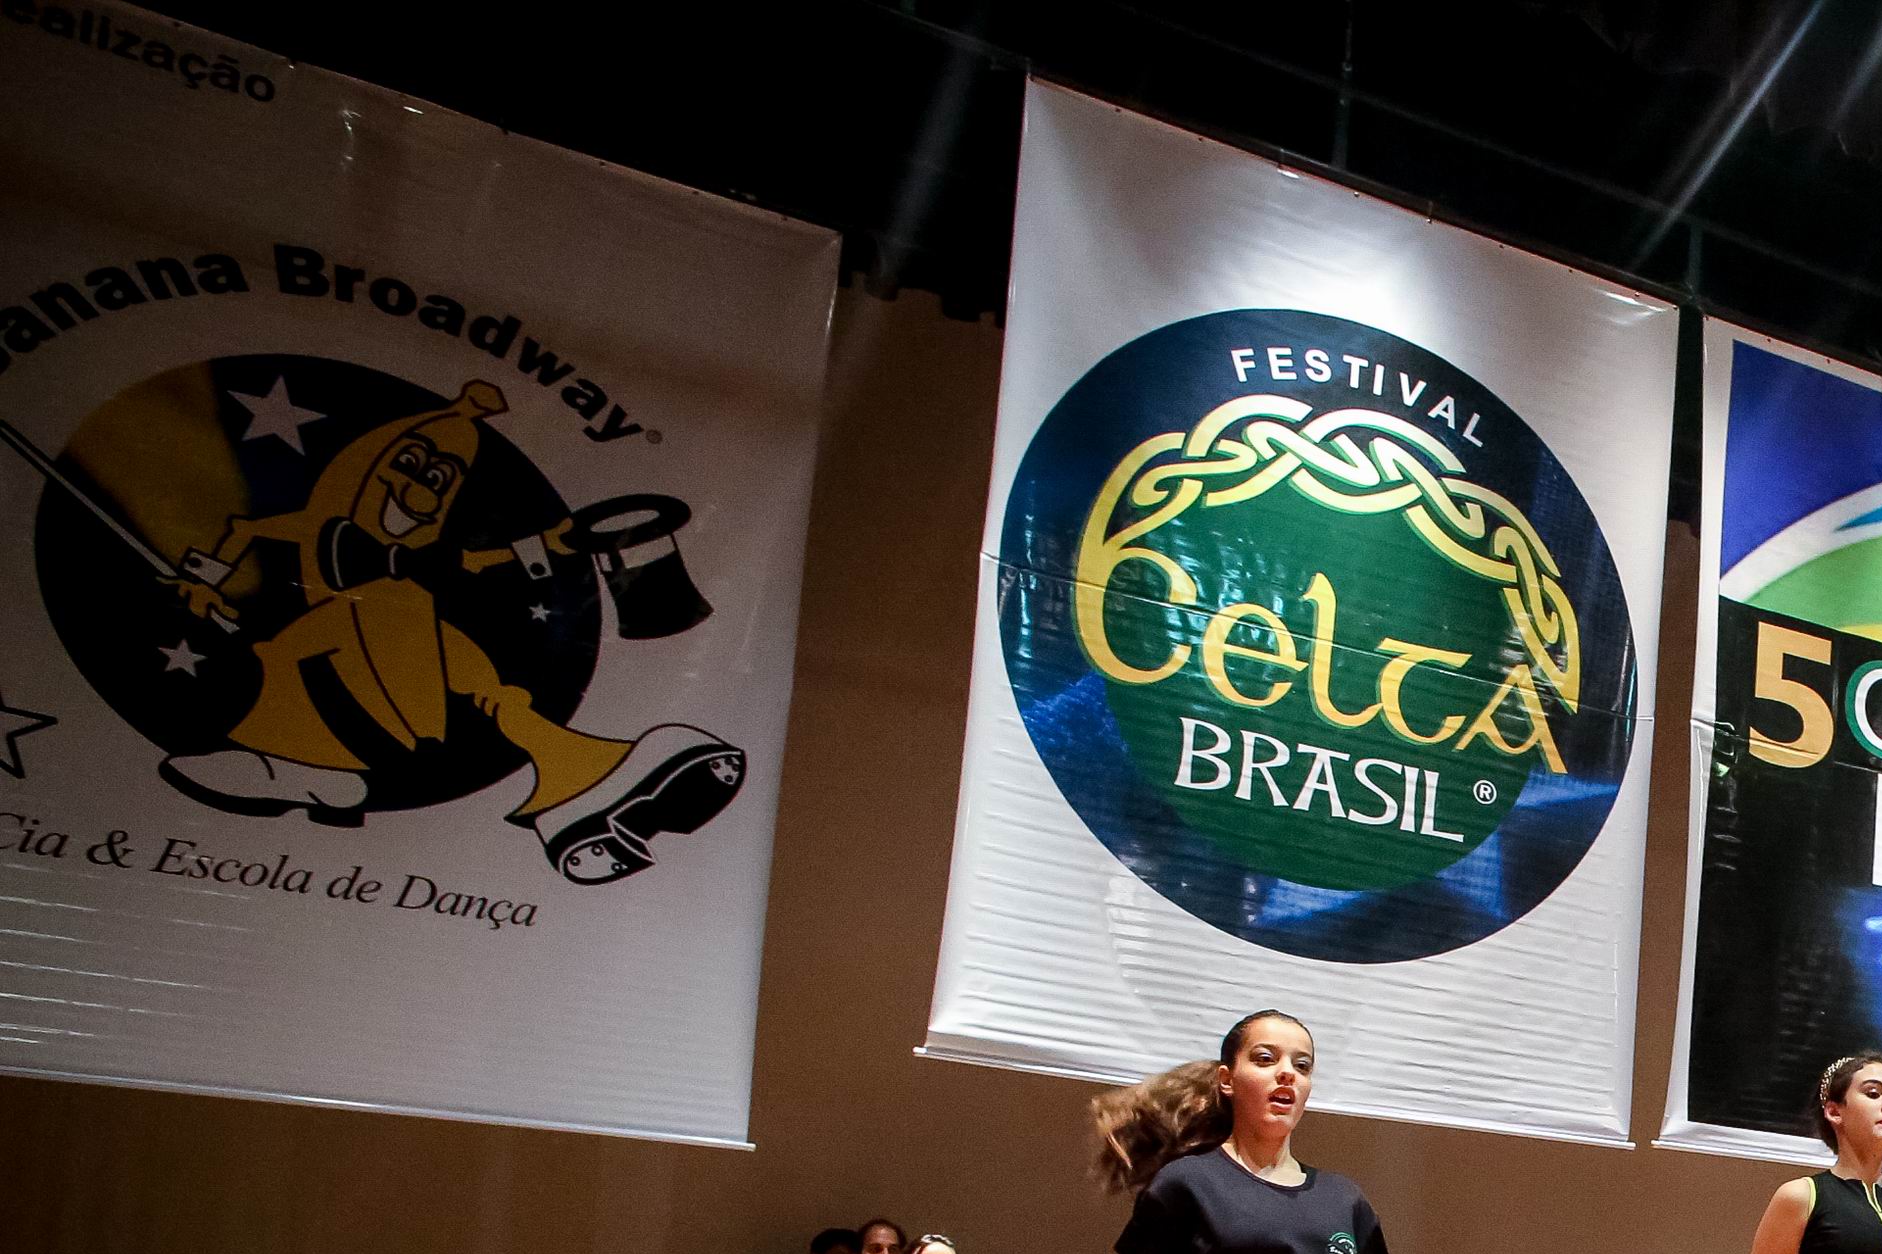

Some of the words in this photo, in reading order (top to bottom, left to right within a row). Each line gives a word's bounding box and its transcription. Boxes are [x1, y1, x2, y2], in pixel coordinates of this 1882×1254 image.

[1, 0, 276, 102] ealização
[0, 254, 250, 375] anana
[273, 242, 644, 443] Broadway
[1230, 346, 1484, 448] FESTIVAL
[1074, 478, 1582, 776] Celta
[1173, 716, 1465, 843] BRASIL
[86, 830, 135, 869] &
[149, 836, 314, 895] Escola
[327, 865, 383, 904] de
[393, 874, 539, 930] Dança
